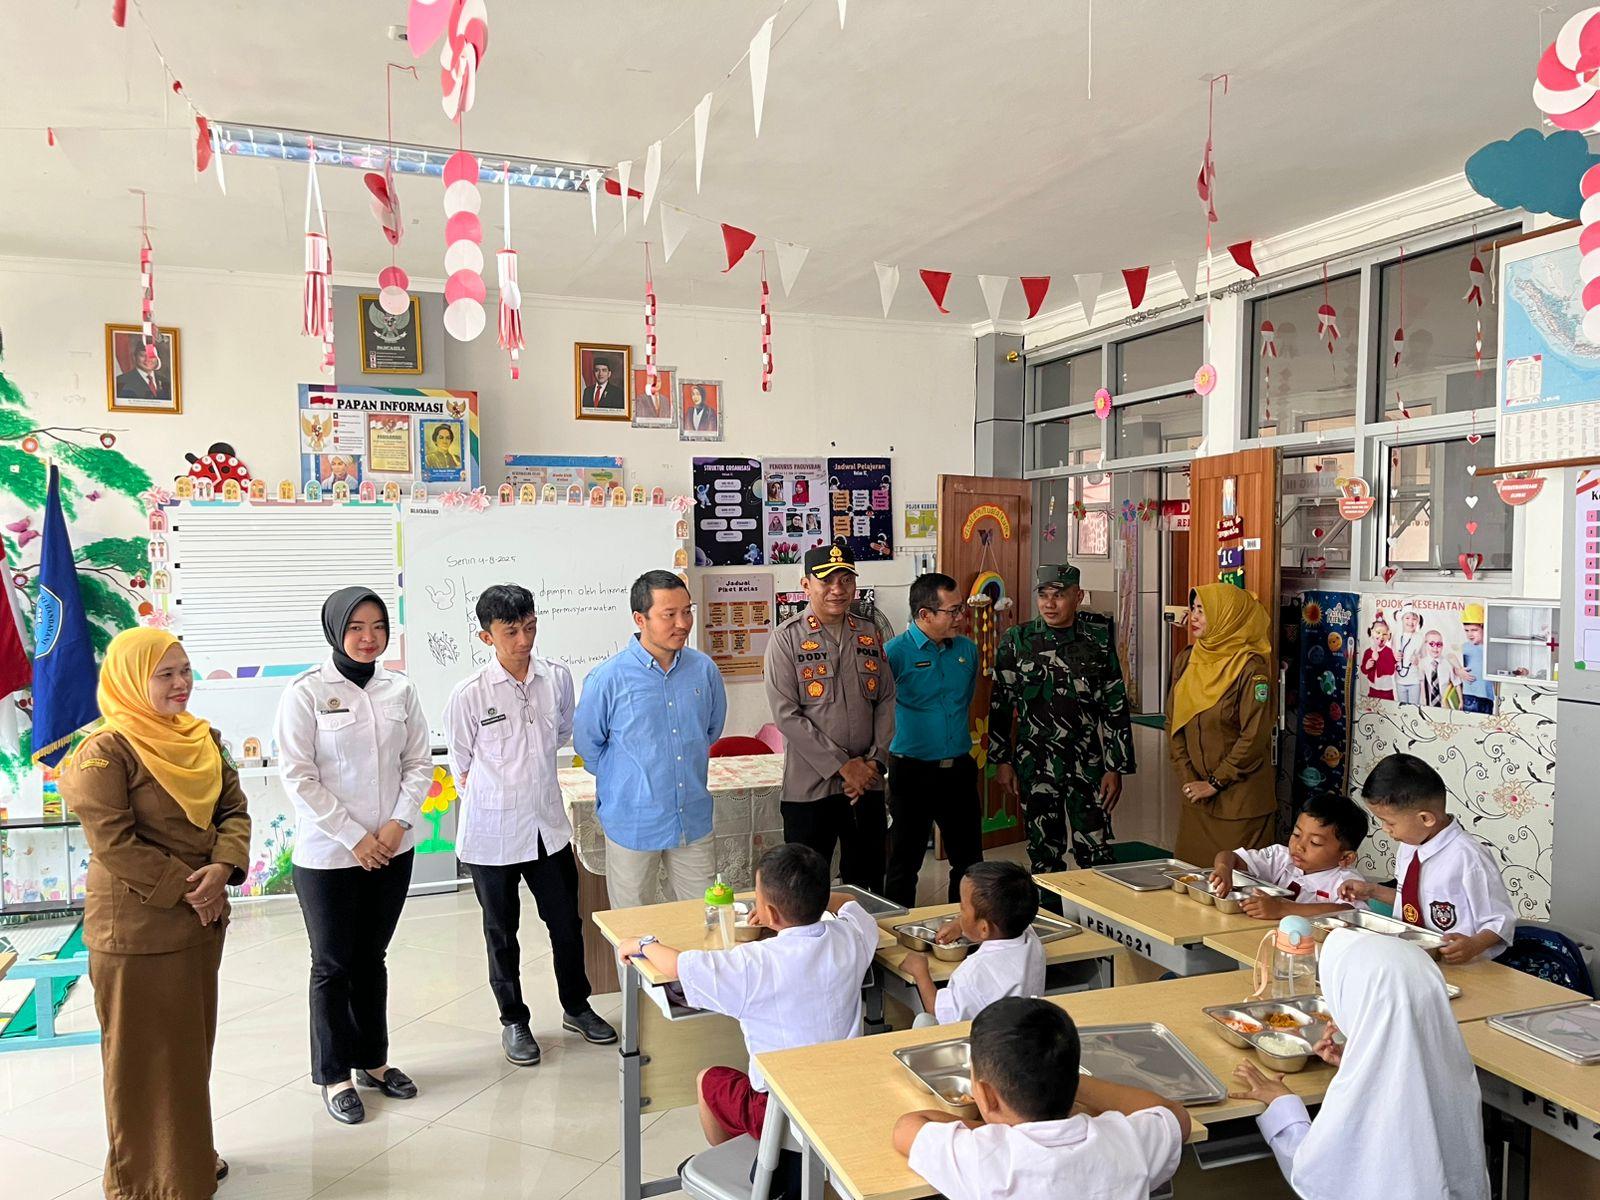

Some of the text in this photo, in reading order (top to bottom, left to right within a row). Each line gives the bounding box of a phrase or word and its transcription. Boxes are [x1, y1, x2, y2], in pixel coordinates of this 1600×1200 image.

[337, 399, 444, 413] PAPAN INFORMASI
[857, 463, 886, 471] Pelajaran
[446, 555, 476, 568] Senin
[1375, 599, 1466, 611] POJOK KESEHATAN
[797, 652, 828, 662] DODY
[1086, 915, 1152, 957] PEN2021
